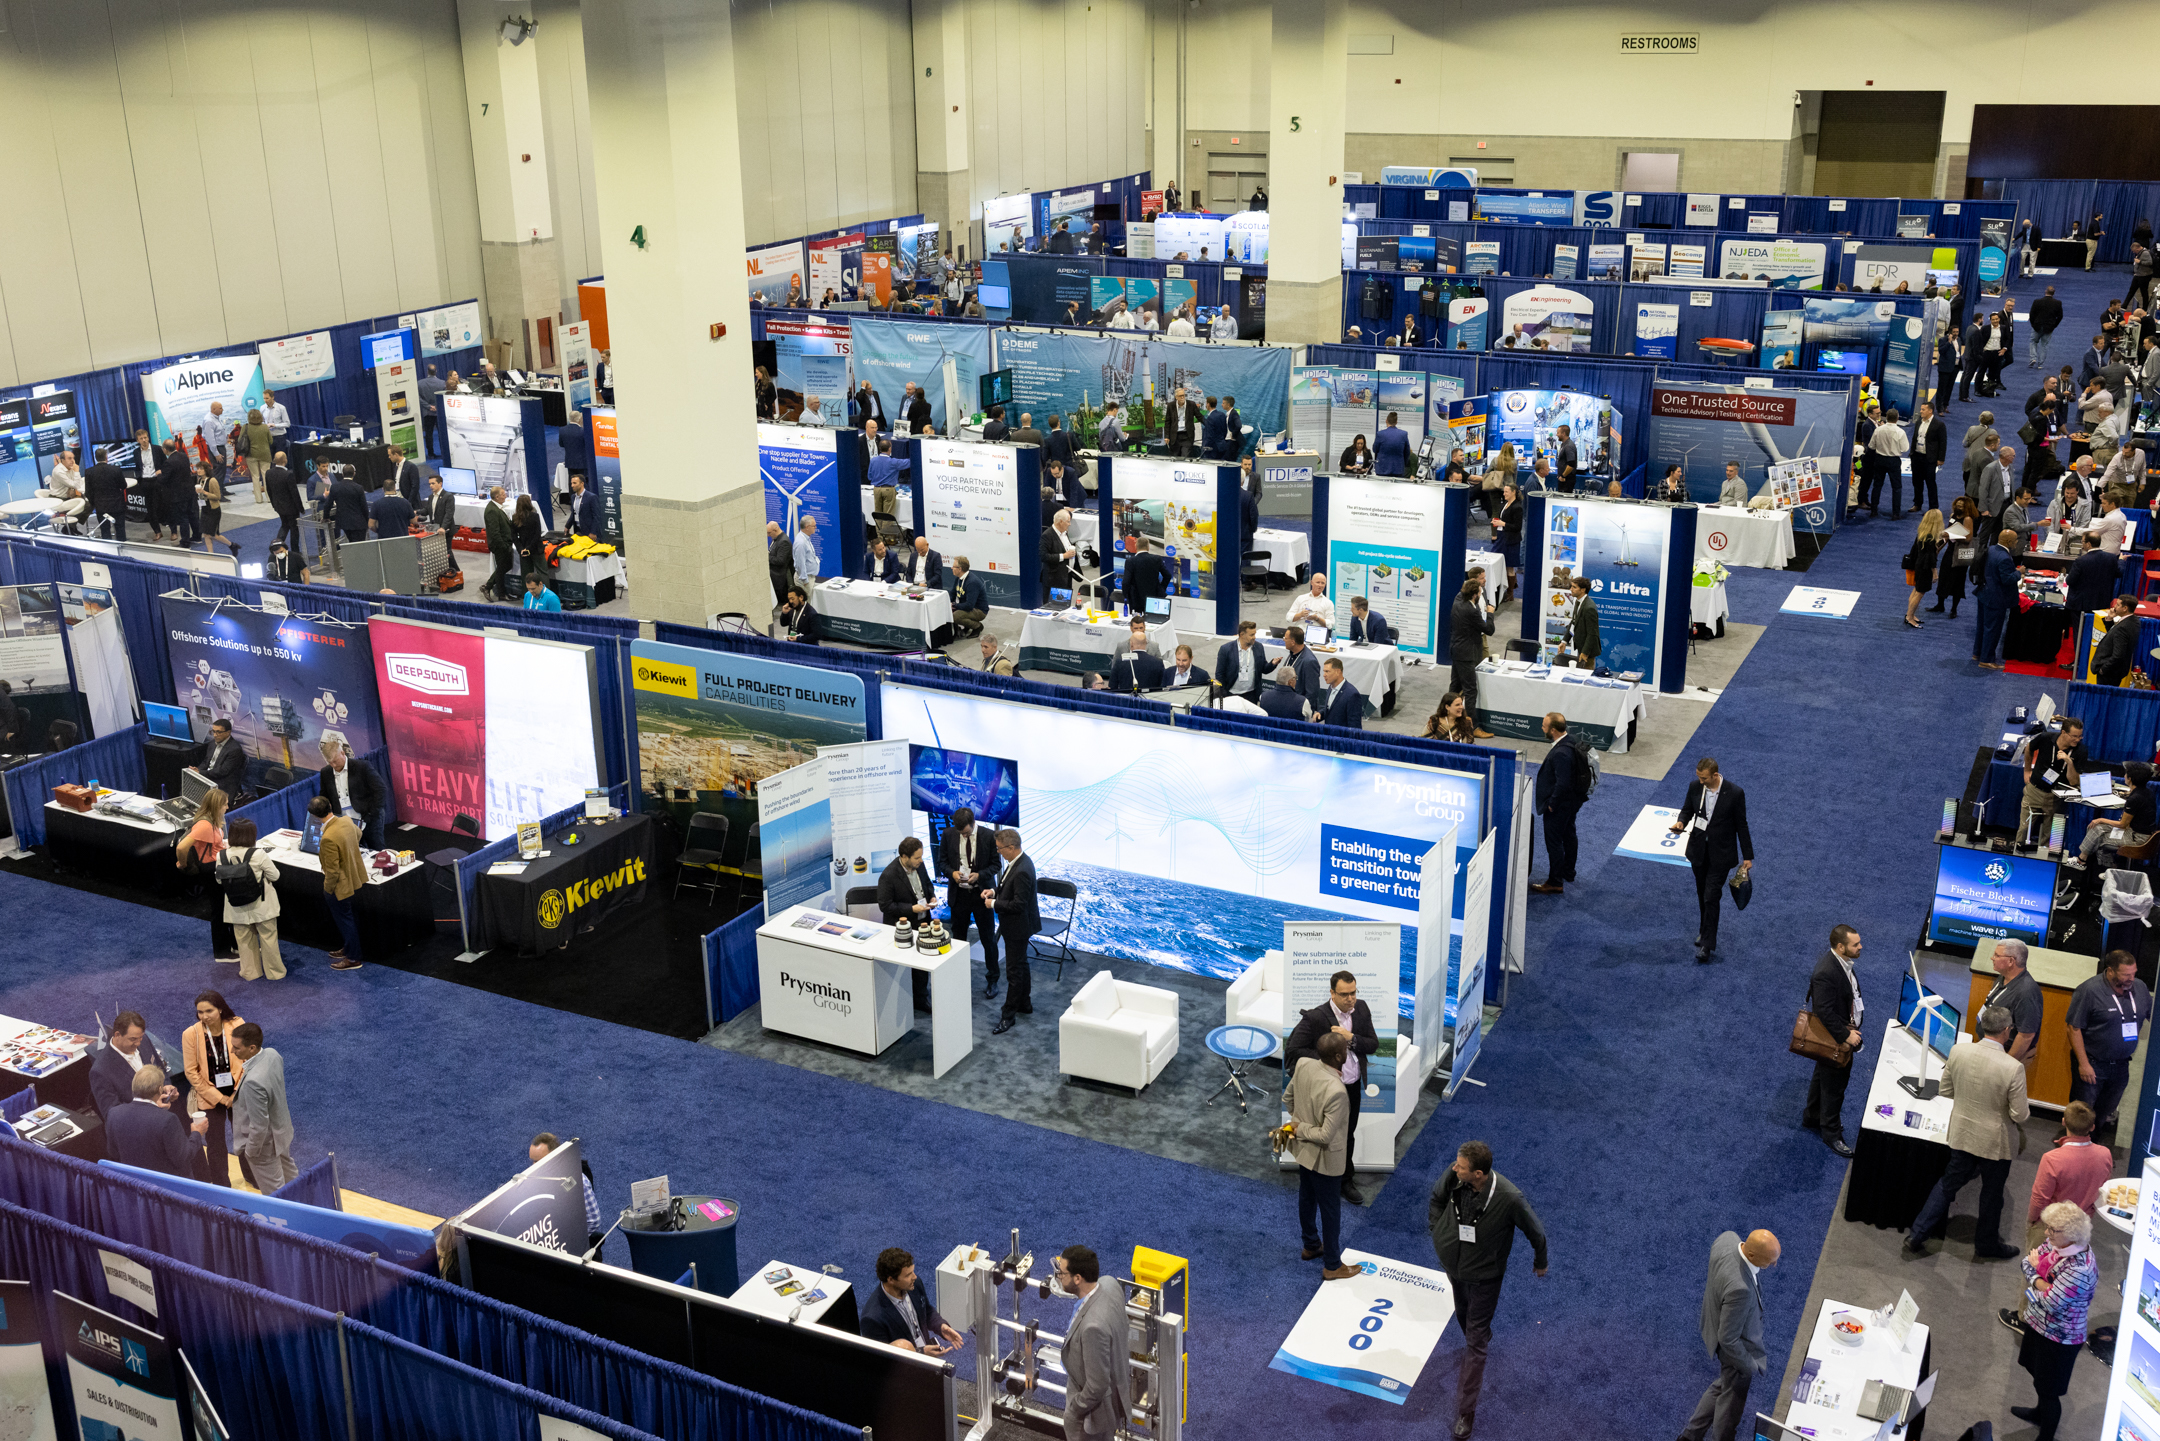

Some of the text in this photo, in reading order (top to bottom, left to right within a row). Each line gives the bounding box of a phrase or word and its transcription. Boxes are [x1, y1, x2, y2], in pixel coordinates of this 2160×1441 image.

[1621, 37, 1697, 49] RESTROOMS
[926, 67, 932, 78] 8
[481, 103, 489, 117] 7
[1290, 116, 1300, 132] 5
[1385, 174, 1430, 185] VIRGINIA
[1528, 201, 1549, 209] Atlantic
[630, 225, 646, 249] 4
[811, 253, 828, 264] NL
[1673, 250, 1703, 259] Geocomp
[747, 258, 764, 277] NL
[1866, 264, 1899, 278] EDR
[1463, 306, 1476, 314] EN
[907, 333, 930, 343] RWE
[1010, 340, 1038, 349] DEME
[870, 358, 894, 368] offshore
[177, 369, 234, 391] Alpine
[40, 402, 67, 415] Nexans
[1662, 393, 1784, 412] One Trusted Source
[1690, 408, 1716, 417] Advisory
[1719, 411, 1742, 419] Testing
[1745, 412, 1784, 421] Certification
[596, 422, 614, 430] survitec
[806, 434, 825, 442] Gexpro
[790, 466, 810, 475] Offering
[1266, 468, 1290, 481] TDI
[936, 474, 1004, 488] YOUR PARTNER IN
[938, 484, 1002, 496] OFFSHORE WIND
[1811, 511, 1821, 522] UL
[1712, 536, 1723, 547] UL
[1610, 582, 1650, 596] Liftra
[172, 630, 208, 645] Offshore
[209, 636, 249, 652] Solutions
[251, 645, 262, 656] up
[262, 647, 272, 656] to
[274, 647, 290, 660] 550
[279, 628, 346, 647] PFISTERER
[396, 664, 459, 685] DEEPSOUTH
[651, 671, 687, 687] Kiewit
[704, 673, 857, 708] FULL PROJECT DELIVERY
[706, 687, 786, 712] CAPABILITIES
[402, 760, 480, 804] HEAVY
[762, 780, 782, 792] Prysmian
[1374, 774, 1466, 806] Prysmian
[489, 778, 544, 817] LIFT
[764, 796, 782, 810] Pushing
[790, 786, 814, 801] boundaries
[406, 793, 482, 822] & TRANSPORT
[1414, 801, 1465, 822] Group
[1331, 838, 1412, 863] Enabling the
[1330, 855, 1392, 878] transition
[566, 856, 647, 914] Kiewit
[1330, 874, 1420, 899] a greener futu
[1950, 884, 2038, 907] Fischer Block, Inc.
[1292, 930, 1323, 938] Prysmian
[1949, 927, 1970, 935] machine
[1971, 925, 1994, 934] wave
[780, 971, 851, 1002] Prysmian
[813, 994, 852, 1017] Group
[396, 1249, 418, 1259] MYSTIC
[105, 1266, 154, 1296] INTEGRATED POWER SERVICES
[1381, 1266, 1423, 1282] Offshore
[1379, 1272, 1445, 1294] WINDPOWER
[1348, 1298, 1394, 1350] 200
[95, 1329, 121, 1352] IPS
[87, 1389, 158, 1428] SALES & DISTRIBUTION
